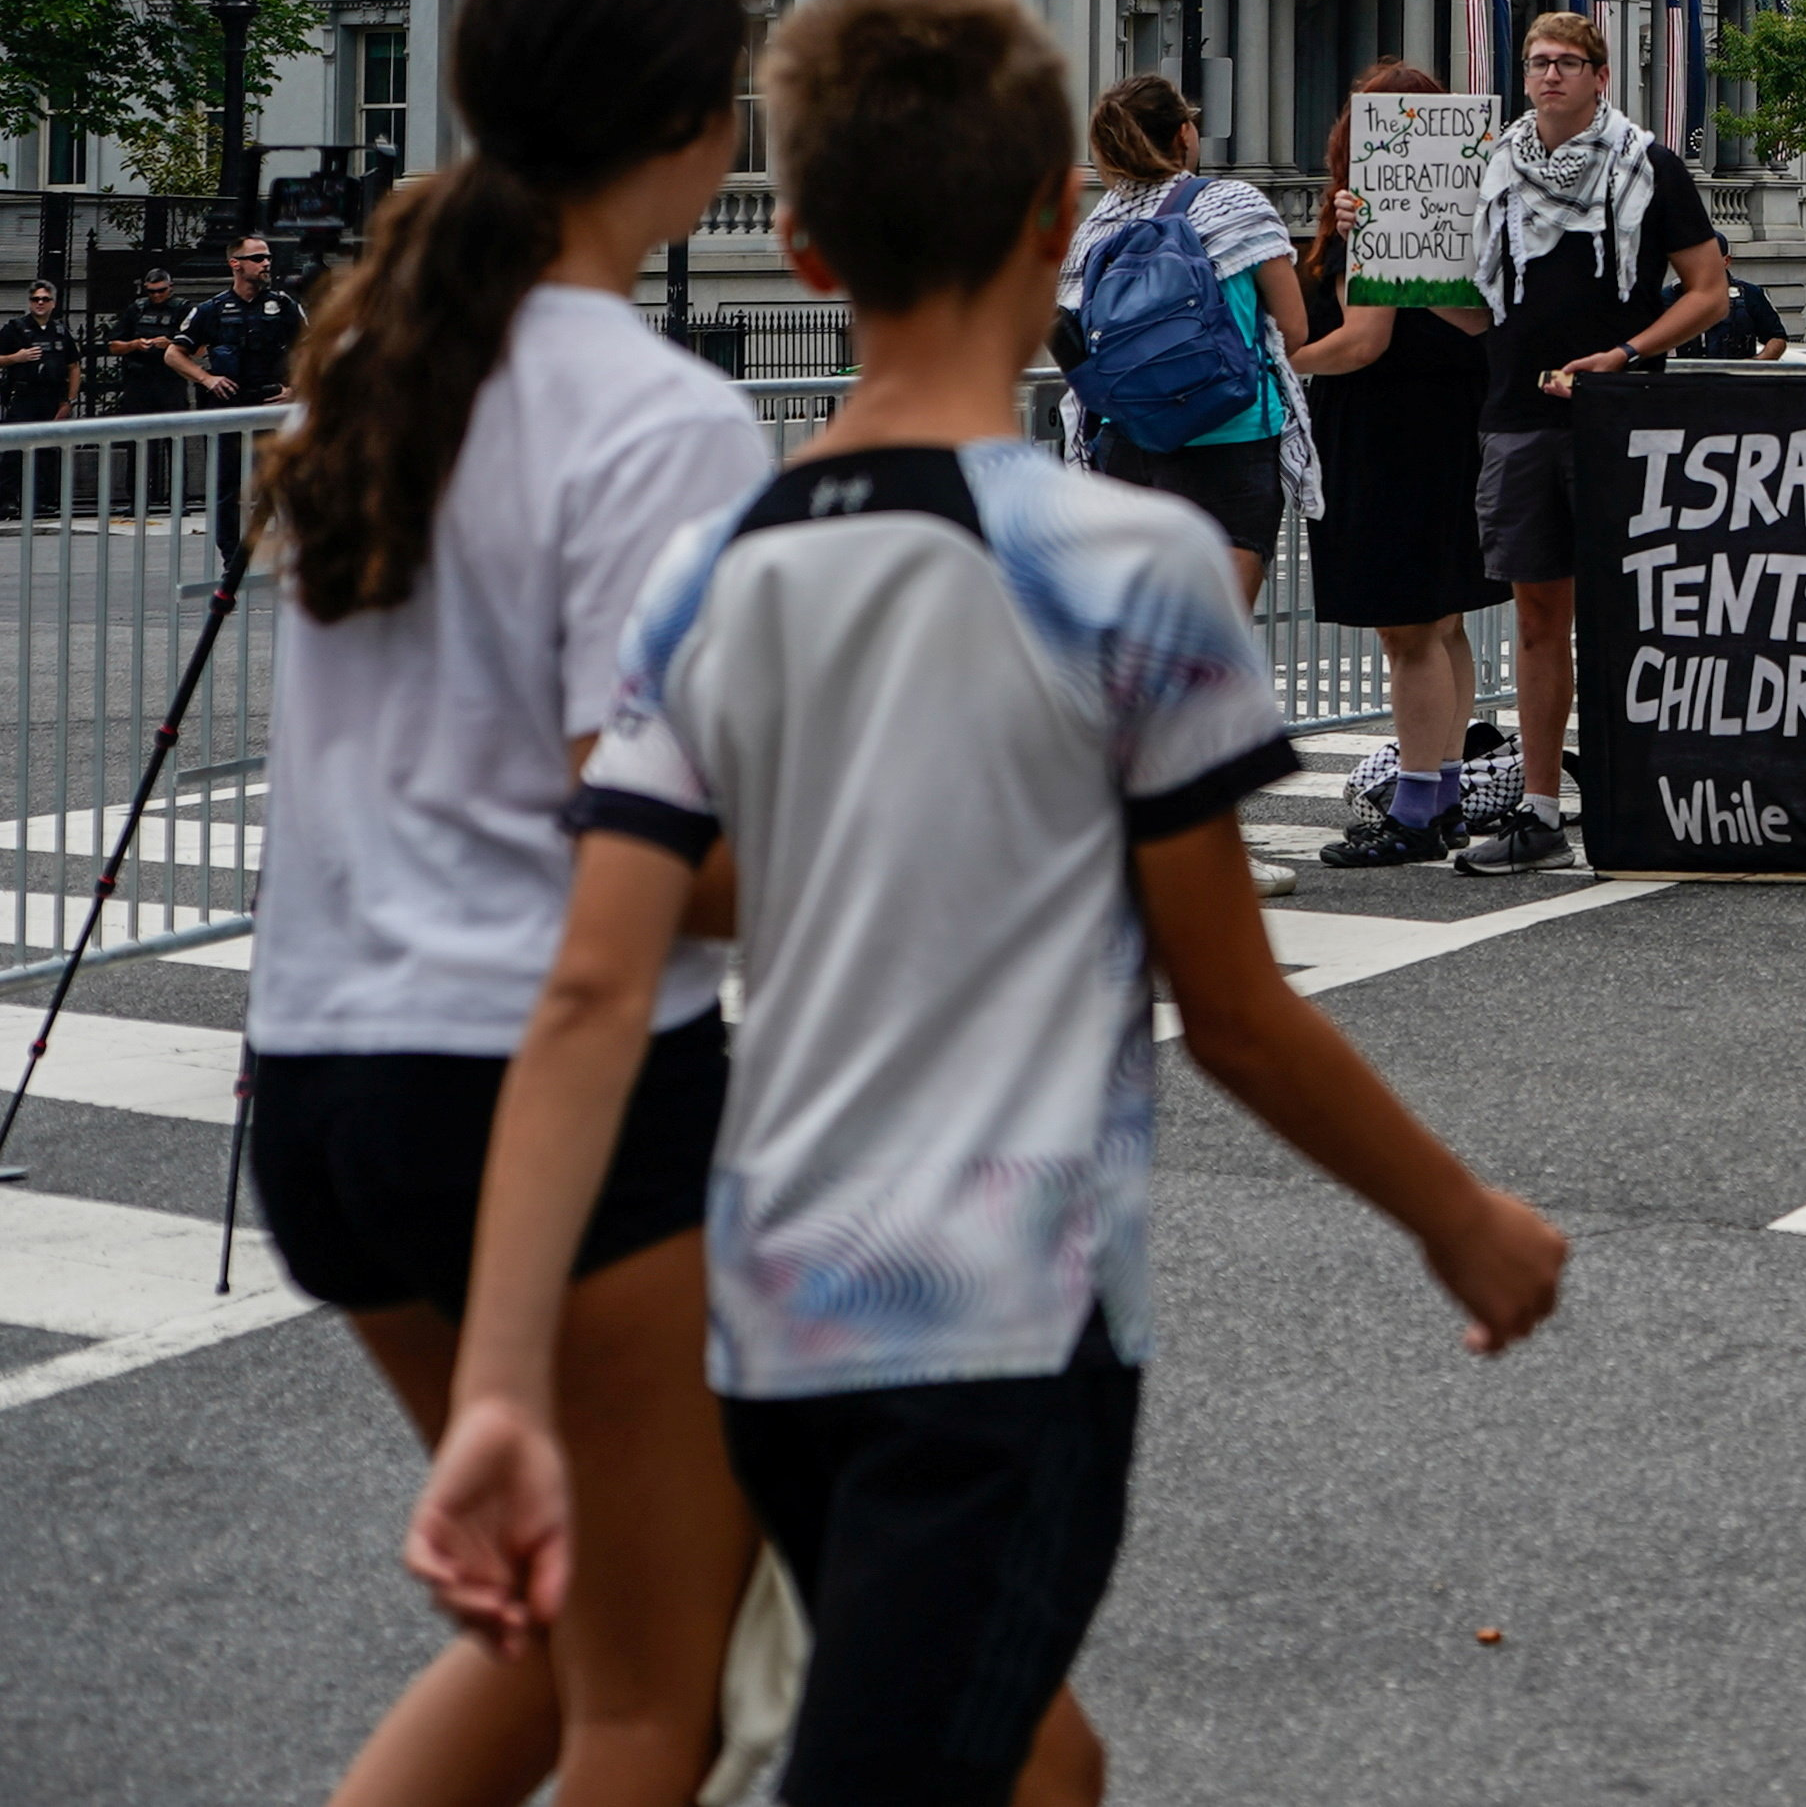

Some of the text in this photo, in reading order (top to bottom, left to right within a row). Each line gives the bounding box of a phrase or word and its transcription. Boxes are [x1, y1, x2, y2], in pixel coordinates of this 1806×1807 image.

[1363, 102, 1476, 137] the SEEDS
[1393, 133, 1412, 158] of
[1363, 163, 1482, 193] LIBERATION
[1379, 196, 1411, 212] are
[1430, 216, 1459, 232] in
[1362, 232, 1473, 261] SOLIDARIT
[1658, 774, 1792, 848] While
